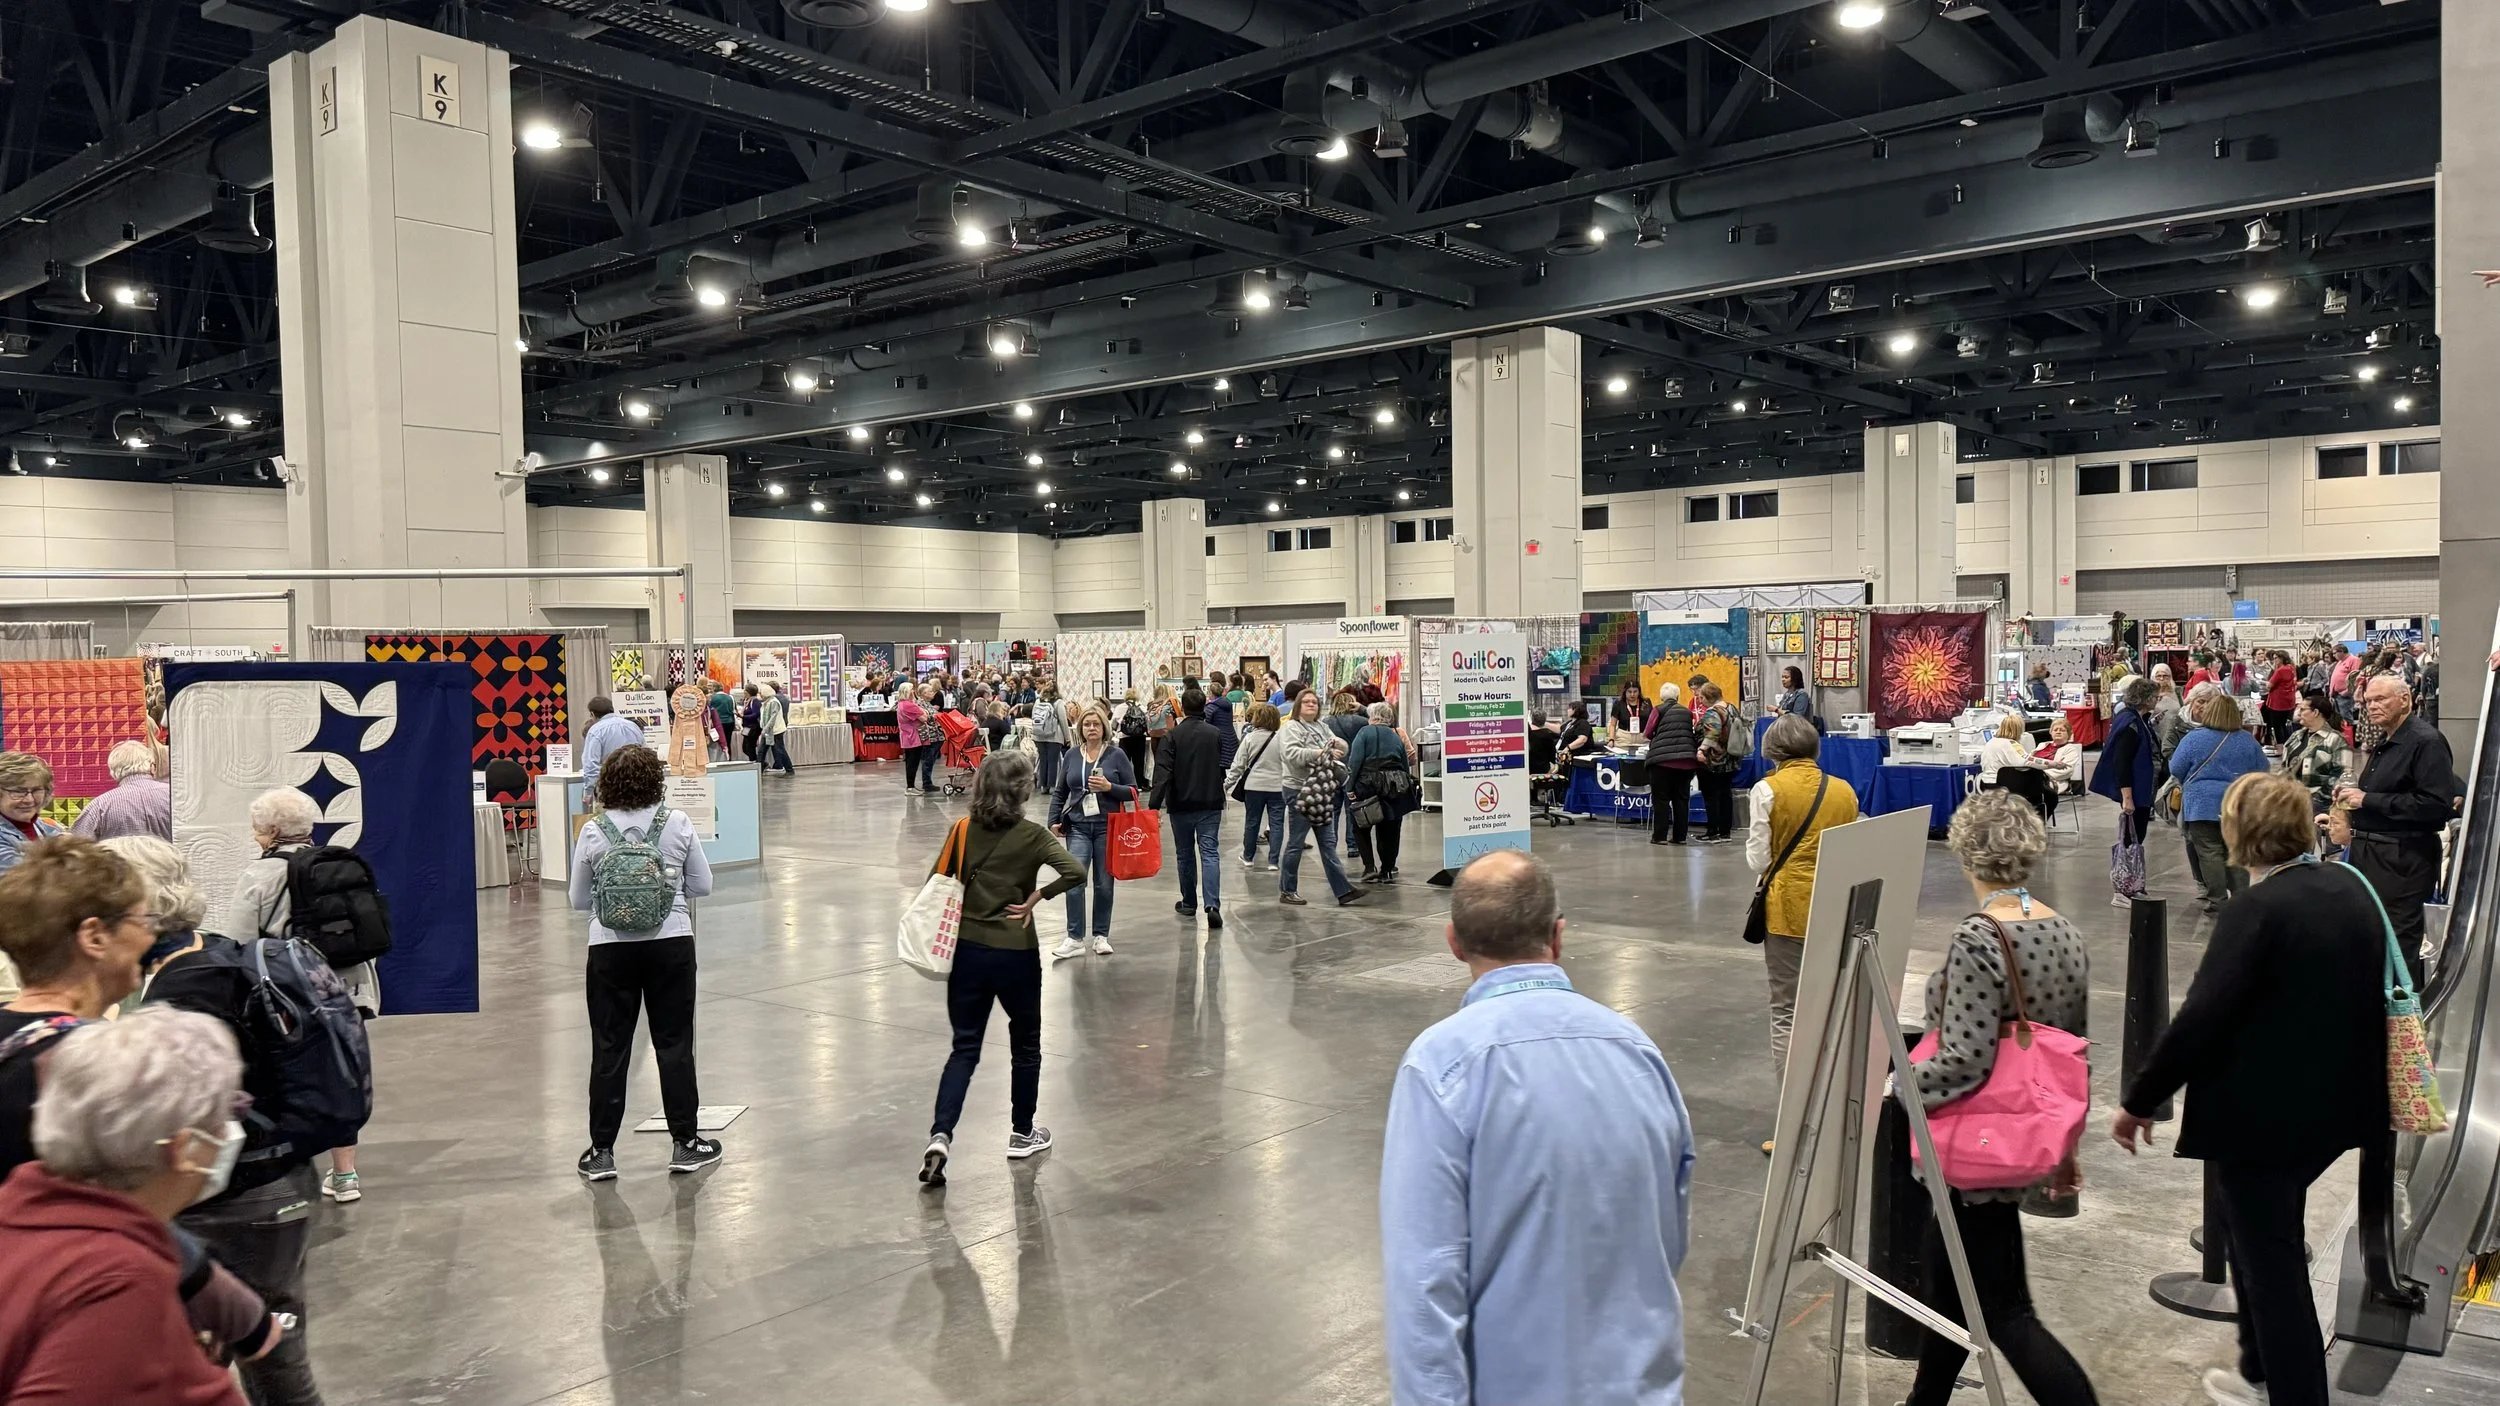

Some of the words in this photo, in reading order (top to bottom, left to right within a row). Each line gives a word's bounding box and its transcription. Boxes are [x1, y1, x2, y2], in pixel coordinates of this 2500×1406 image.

[434, 73, 447, 95] K
[322, 83, 328, 104] K
[435, 100, 447, 120] 9
[323, 110, 328, 130] 9
[1496, 354, 1504, 365] N
[1498, 368, 1502, 377] 9
[1340, 620, 1400, 635] Spoonflower
[1452, 650, 1514, 670] QuiltCon
[1458, 692, 1482, 702] Show
[1484, 692, 1512, 700] Hours:
[1614, 795, 1625, 806] at
[1627, 797, 1652, 810] you
